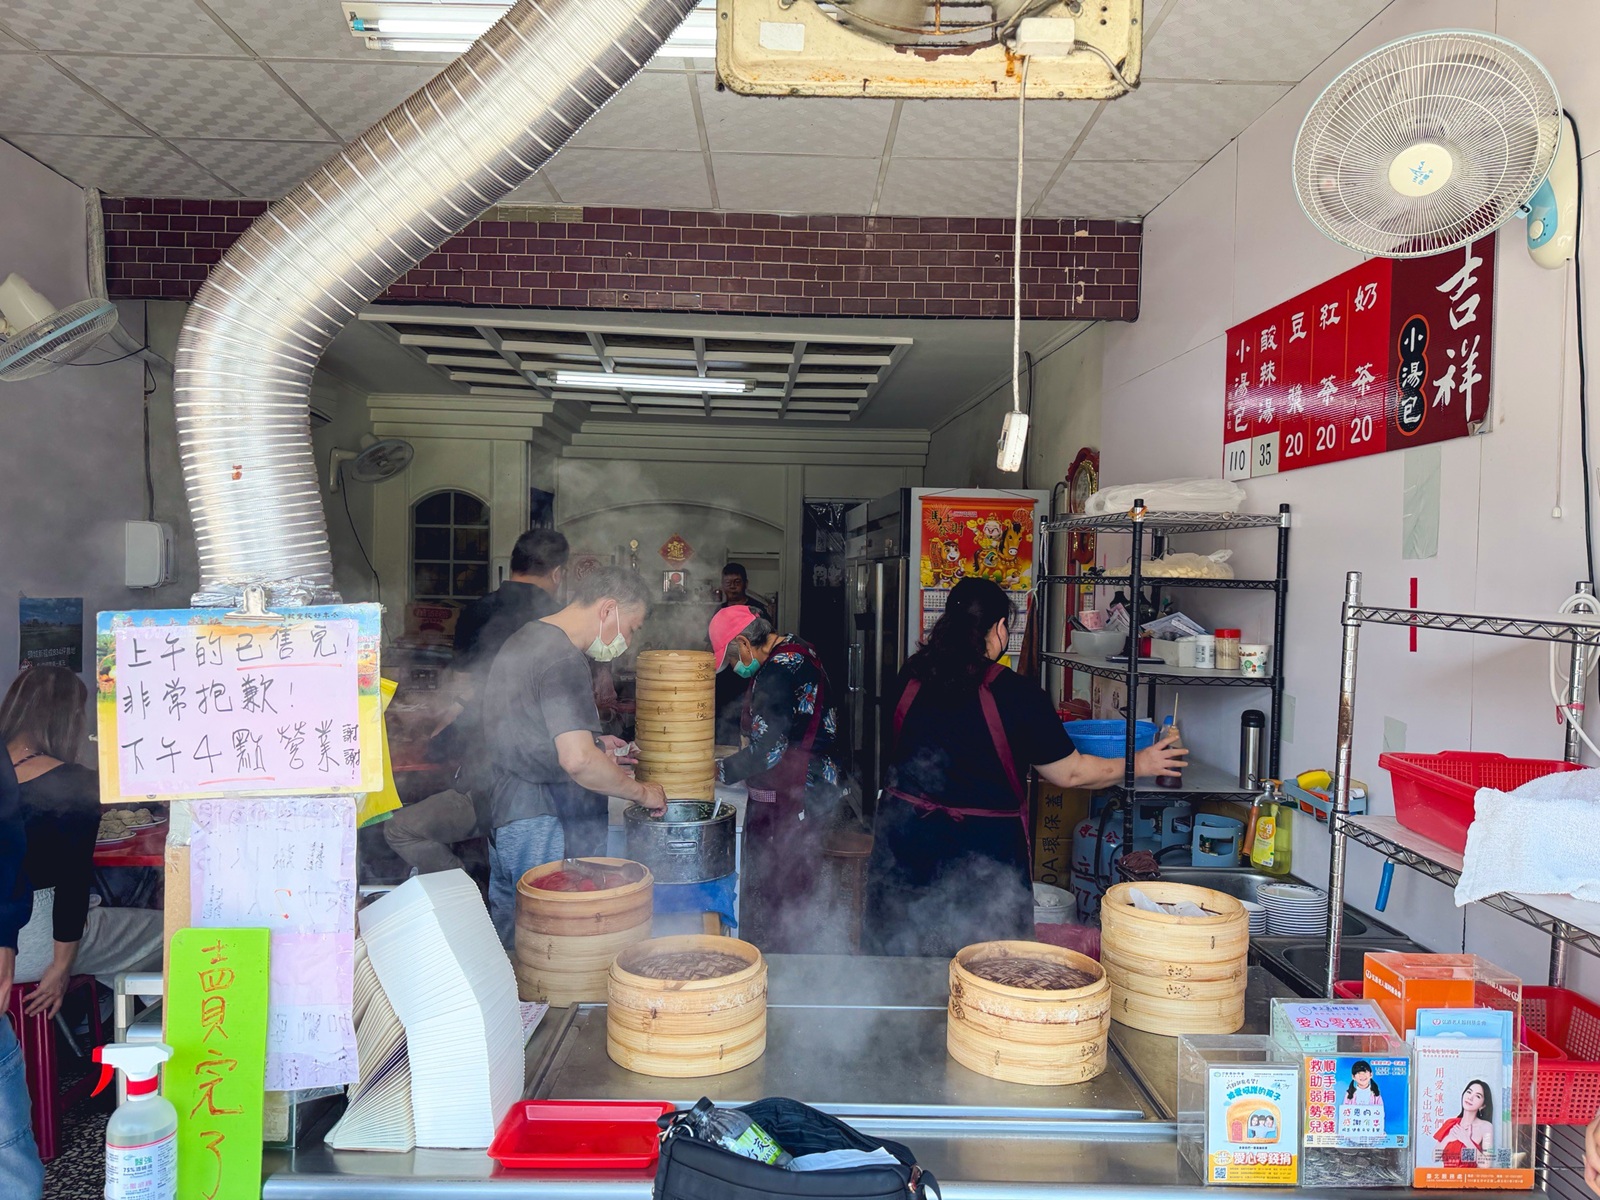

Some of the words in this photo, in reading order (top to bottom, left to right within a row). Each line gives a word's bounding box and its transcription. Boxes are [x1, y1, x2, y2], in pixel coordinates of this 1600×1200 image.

[1317, 302, 1341, 406] 紅茶
[1351, 282, 1378, 396] 奶茶
[1433, 243, 1483, 421] 吉祥
[1234, 338, 1250, 432] 小湯包
[1259, 325, 1278, 424] 酸辣湯
[1401, 327, 1423, 424] 小湯包
[1229, 450, 1246, 471] 110
[1259, 443, 1272, 467] 35
[1285, 432, 1303, 458] 20
[1316, 424, 1336, 451] 20
[1350, 415, 1373, 444] 20
[122, 674, 294, 722] 非常抱歉!
[1296, 1016, 1382, 1029] 愛心零錢捐
[190, 939, 244, 1200] 賣完了
[1310, 1060, 1323, 1134] 救助弱勢兒
[1323, 1060, 1336, 1134] 順手捐零錢
[1434, 1067, 1445, 1130] 用愛讓他們
[1421, 1086, 1433, 1136] 走出孤寒
[1233, 1152, 1291, 1166] 愛心零錢捐
